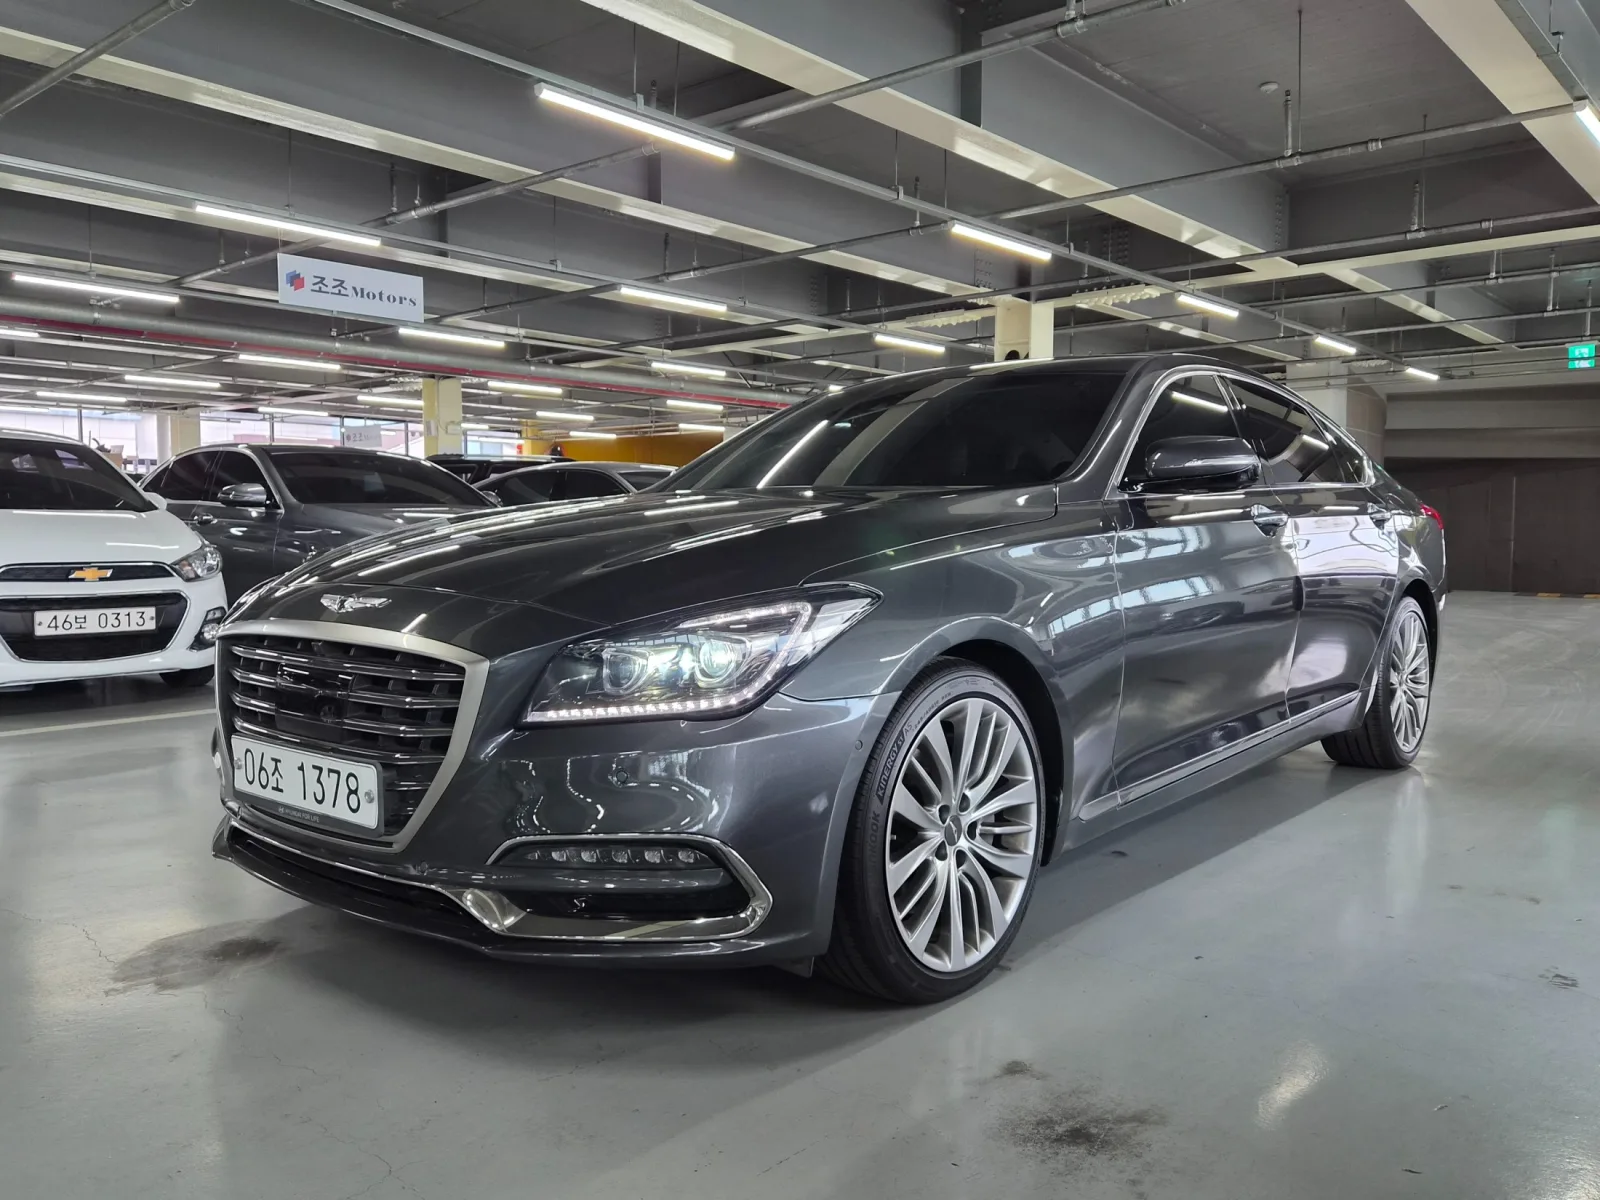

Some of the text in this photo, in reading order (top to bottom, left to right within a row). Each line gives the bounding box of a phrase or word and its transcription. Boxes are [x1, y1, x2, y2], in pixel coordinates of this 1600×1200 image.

[47, 611, 146, 631] 46보 0313
[244, 747, 361, 814] 06조 1378
